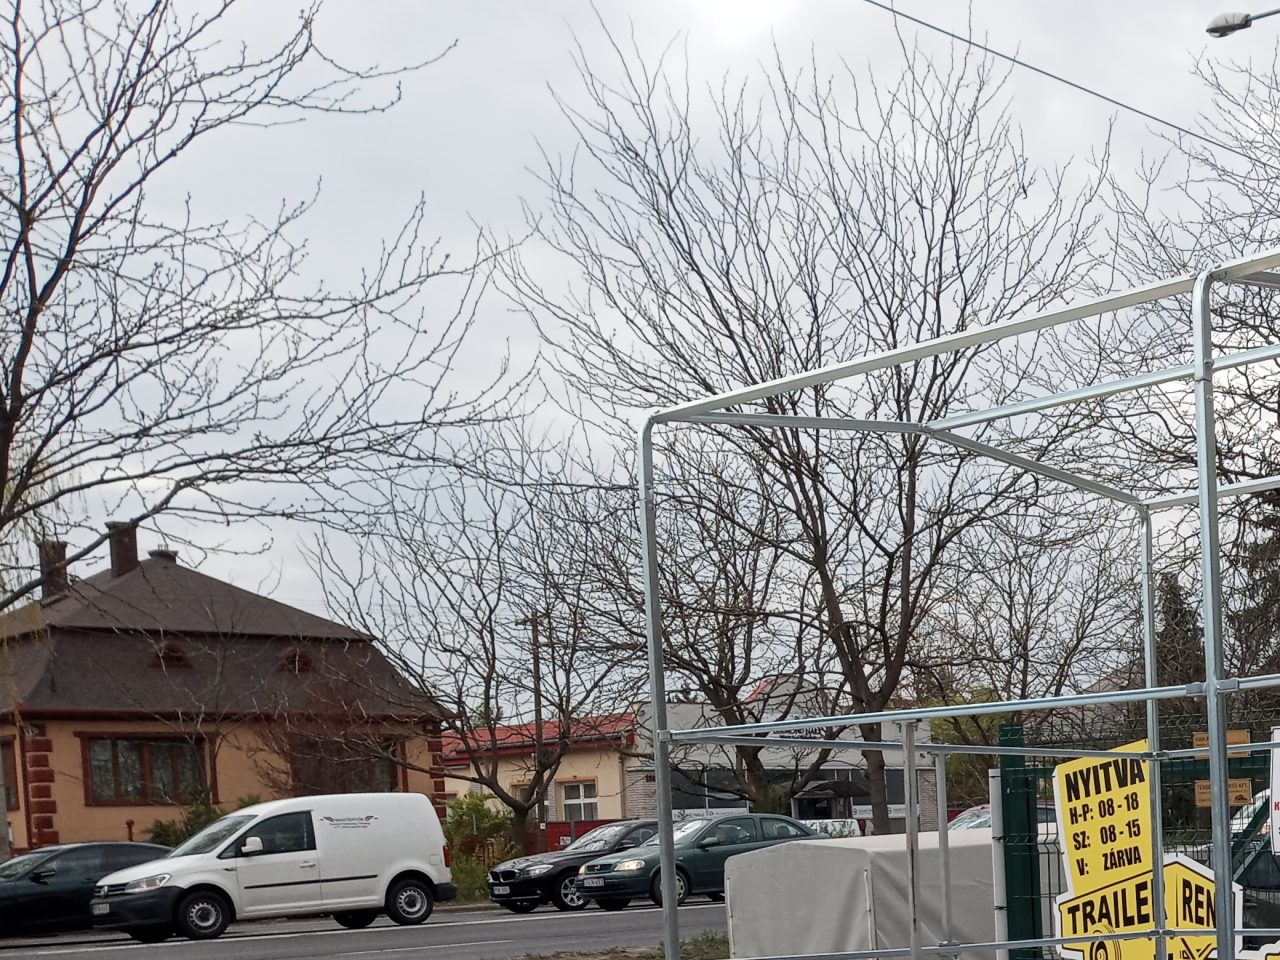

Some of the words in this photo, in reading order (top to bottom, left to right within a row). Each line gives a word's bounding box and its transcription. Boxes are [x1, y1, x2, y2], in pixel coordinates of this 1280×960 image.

[1065, 758, 1145, 803] NYITVA
[1069, 803, 1094, 825] H-P:
[1098, 798, 1115, 818] 08
[1124, 791, 1139, 811] 18
[1072, 831, 1091, 851] SZ:
[1100, 824, 1117, 844] 08
[1125, 818, 1141, 838] 15
[1076, 858, 1089, 877] V:
[1102, 846, 1142, 871] ZÁRVA
[1182, 878, 1216, 929] REN
